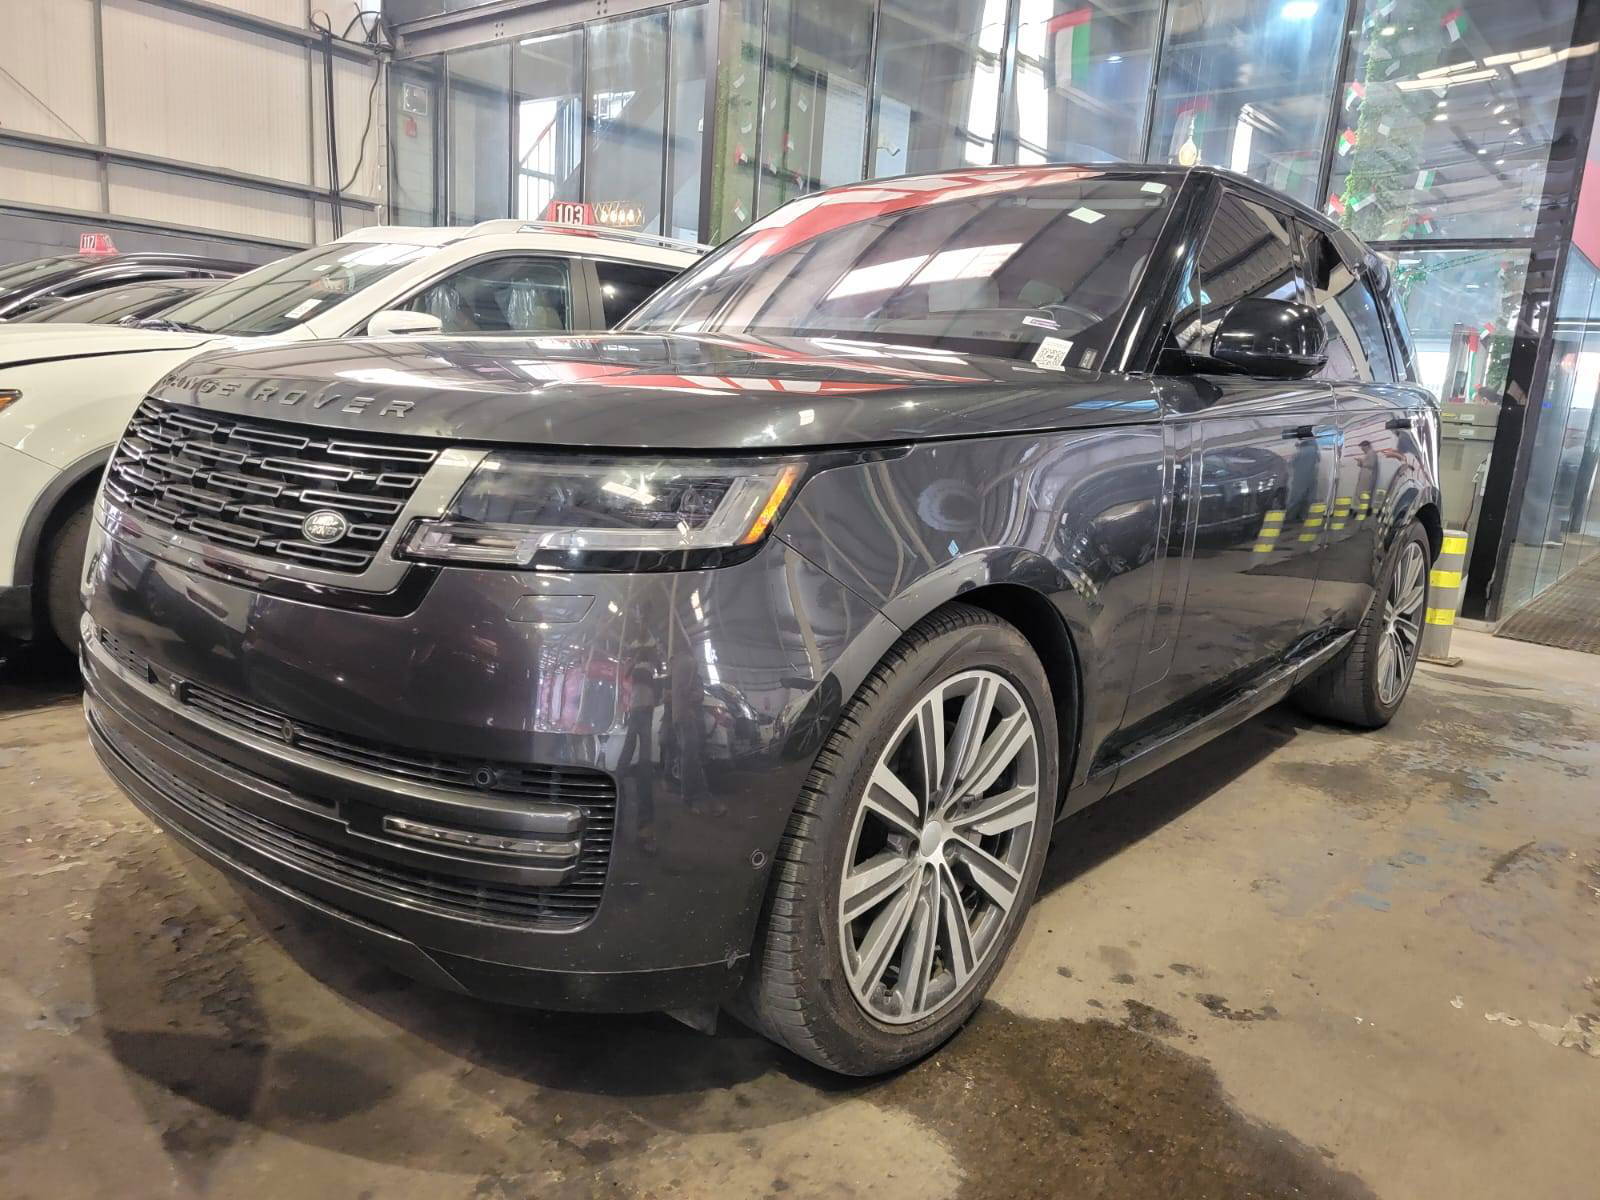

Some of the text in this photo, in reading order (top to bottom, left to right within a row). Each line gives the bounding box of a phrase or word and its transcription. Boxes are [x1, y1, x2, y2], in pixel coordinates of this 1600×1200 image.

[557, 203, 584, 226] 103
[83, 235, 96, 249] 117
[253, 386, 416, 418] ROVER
